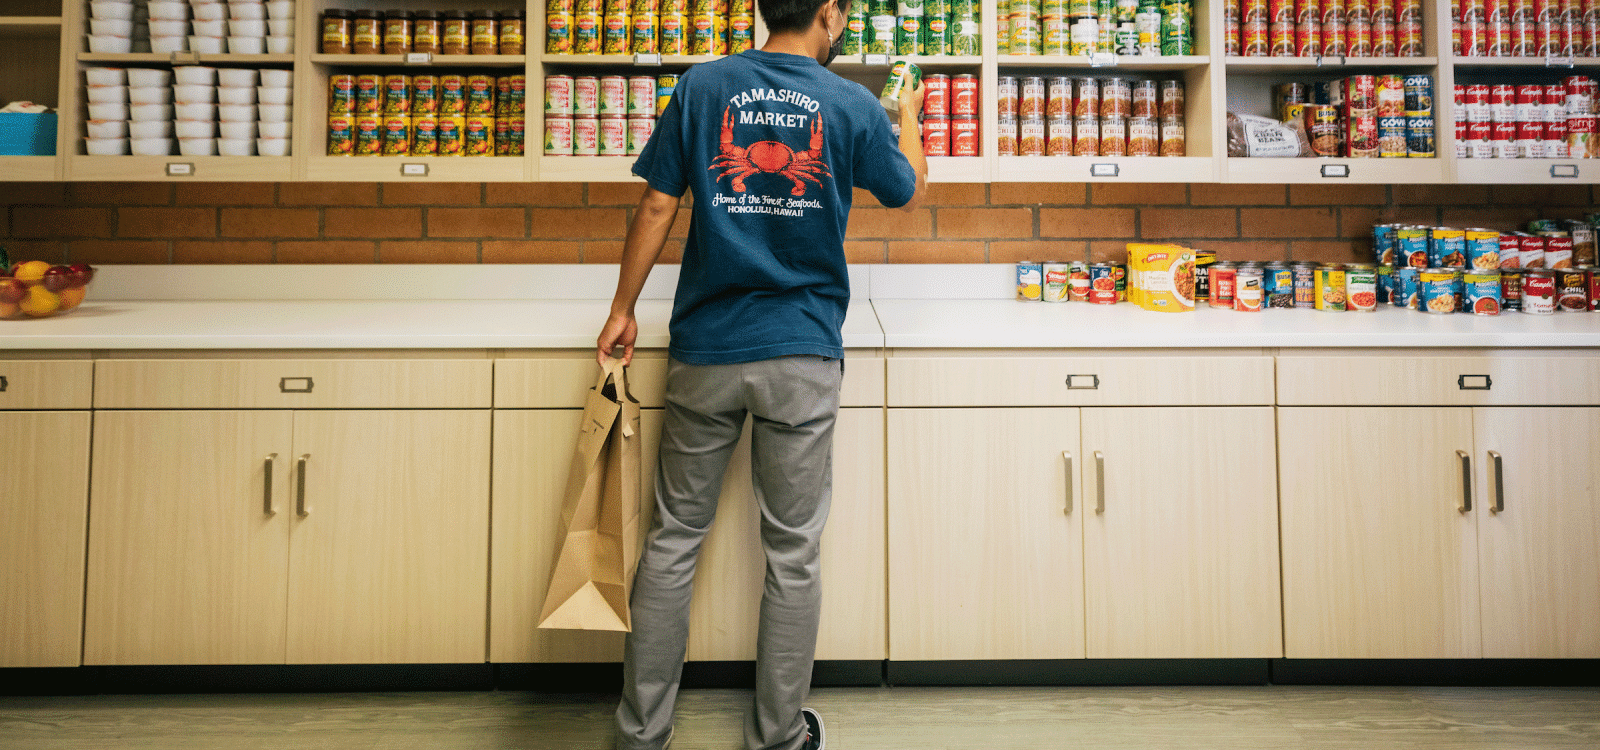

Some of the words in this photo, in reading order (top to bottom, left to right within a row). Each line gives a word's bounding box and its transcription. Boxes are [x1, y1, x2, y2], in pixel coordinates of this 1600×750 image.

[730, 88, 820, 113] TAMASHIRO
[739, 110, 807, 128] MARKET
[712, 193, 736, 207] Home
[738, 193, 747, 205] of
[748, 195, 761, 205] the
[761, 195, 785, 206] Finest
[773, 207, 804, 217] HAWAII
